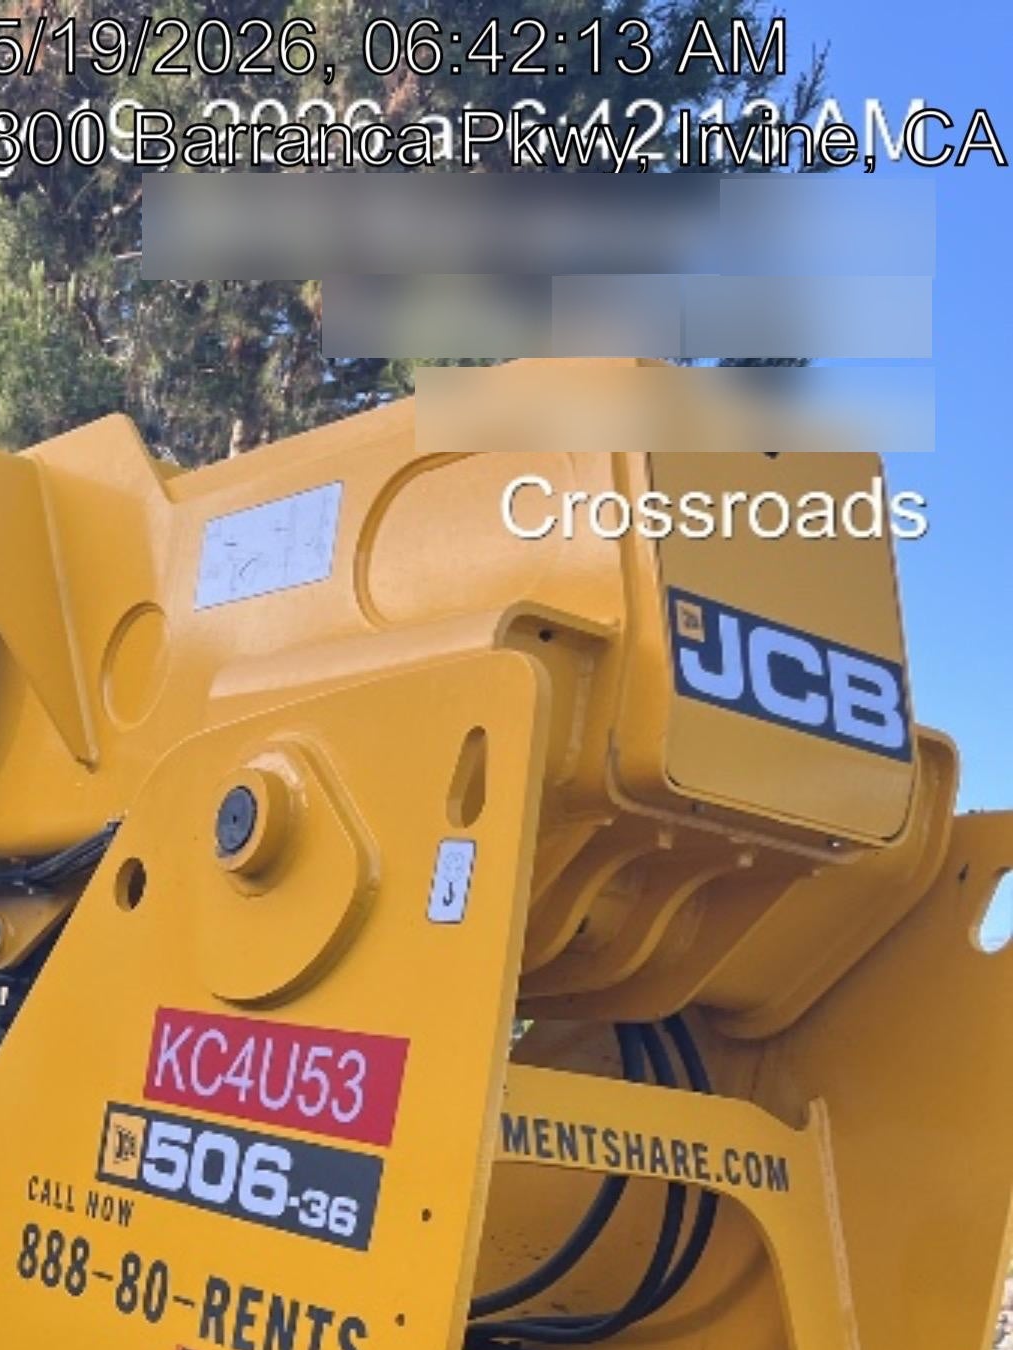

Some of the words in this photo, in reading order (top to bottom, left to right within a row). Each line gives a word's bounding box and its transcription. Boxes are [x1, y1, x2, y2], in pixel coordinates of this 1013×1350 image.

[679, 613, 905, 751] JCB
[154, 1022, 368, 1124] KC4U53
[27, 1175, 75, 1213] CALL
[85, 1190, 135, 1228] NOW
[141, 1119, 361, 1238] 506-36
[499, 1112, 789, 1193] MENTSHARE.COM
